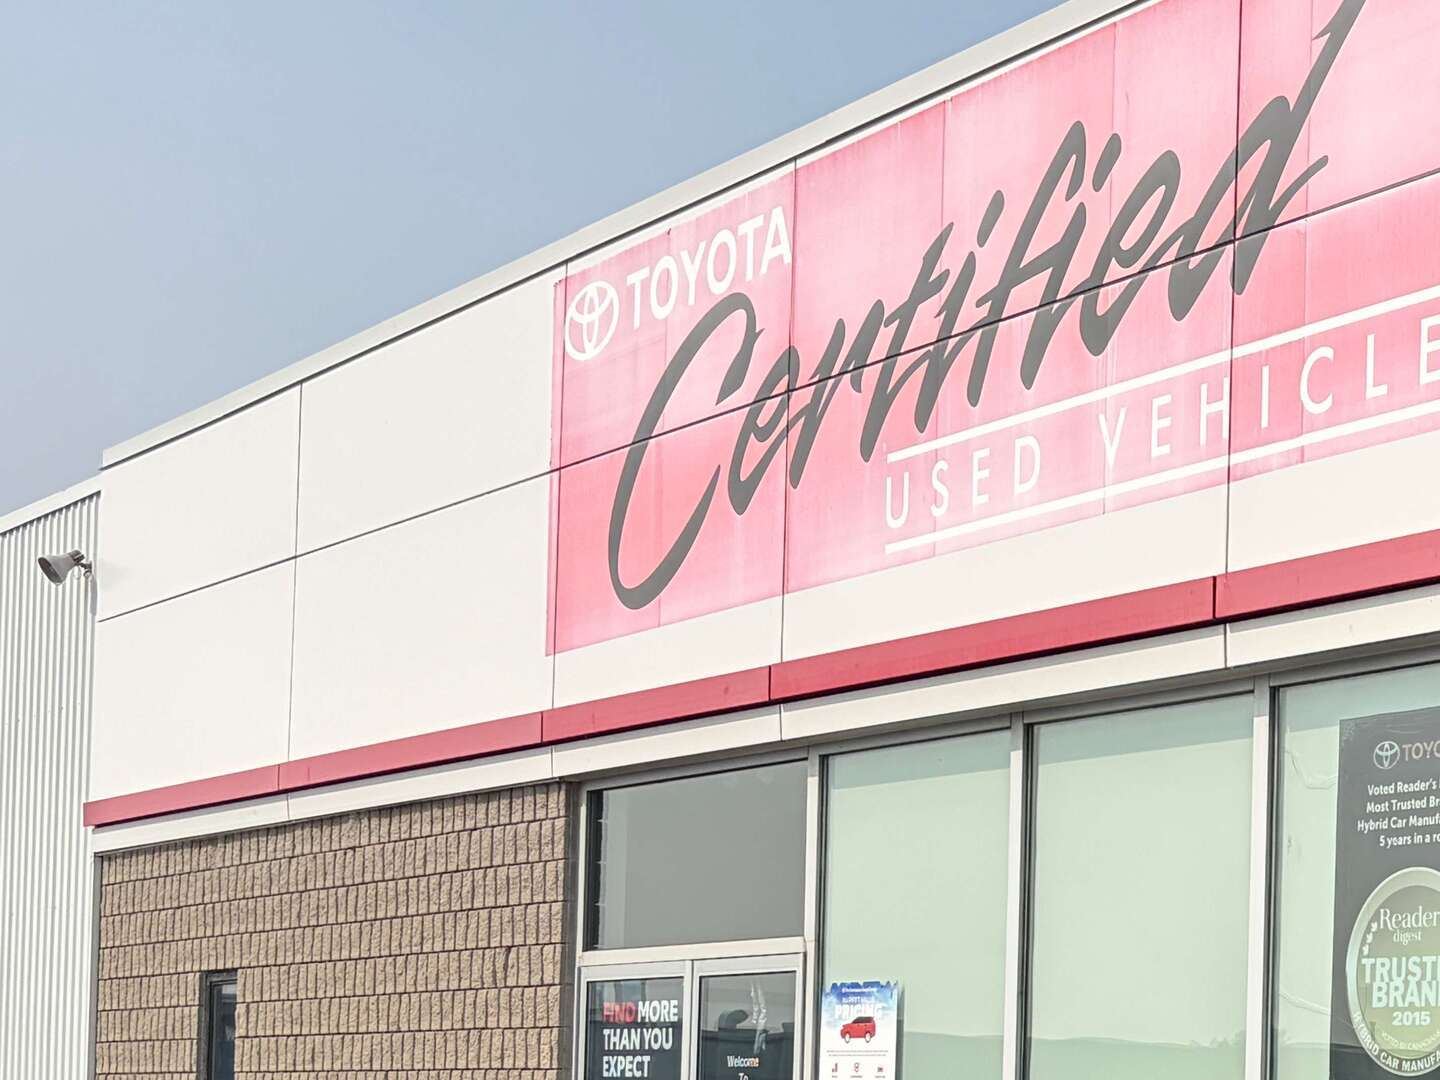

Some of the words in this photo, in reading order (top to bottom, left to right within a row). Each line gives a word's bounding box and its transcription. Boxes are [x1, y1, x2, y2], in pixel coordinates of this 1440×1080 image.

[626, 205, 793, 332] TOYOTA
[607, 0, 1363, 611] Certified
[885, 434, 1042, 530] USED
[1367, 782, 1395, 797] Voted
[1396, 777, 1437, 793] Reader's
[1366, 800, 1389, 814] Most
[1391, 797, 1427, 812] Trusted
[1357, 818, 1388, 834] Hybrid
[1390, 816, 1406, 829] Car
[1379, 835, 1385, 847] 5
[1386, 836, 1412, 849] years
[1413, 832, 1423, 844] in
[1424, 833, 1431, 843] a
[1393, 930, 1423, 945] digest
[637, 999, 679, 1023] MORE
[1392, 1011, 1431, 1026] 2015
[603, 1028, 640, 1051] THAN
[642, 1027, 673, 1050] YOU
[1353, 1010, 1380, 1056] HYBRID
[1379, 1051, 1400, 1070] CAR
[602, 1055, 651, 1078] EXPECT
[727, 1055, 759, 1068] Welcome
